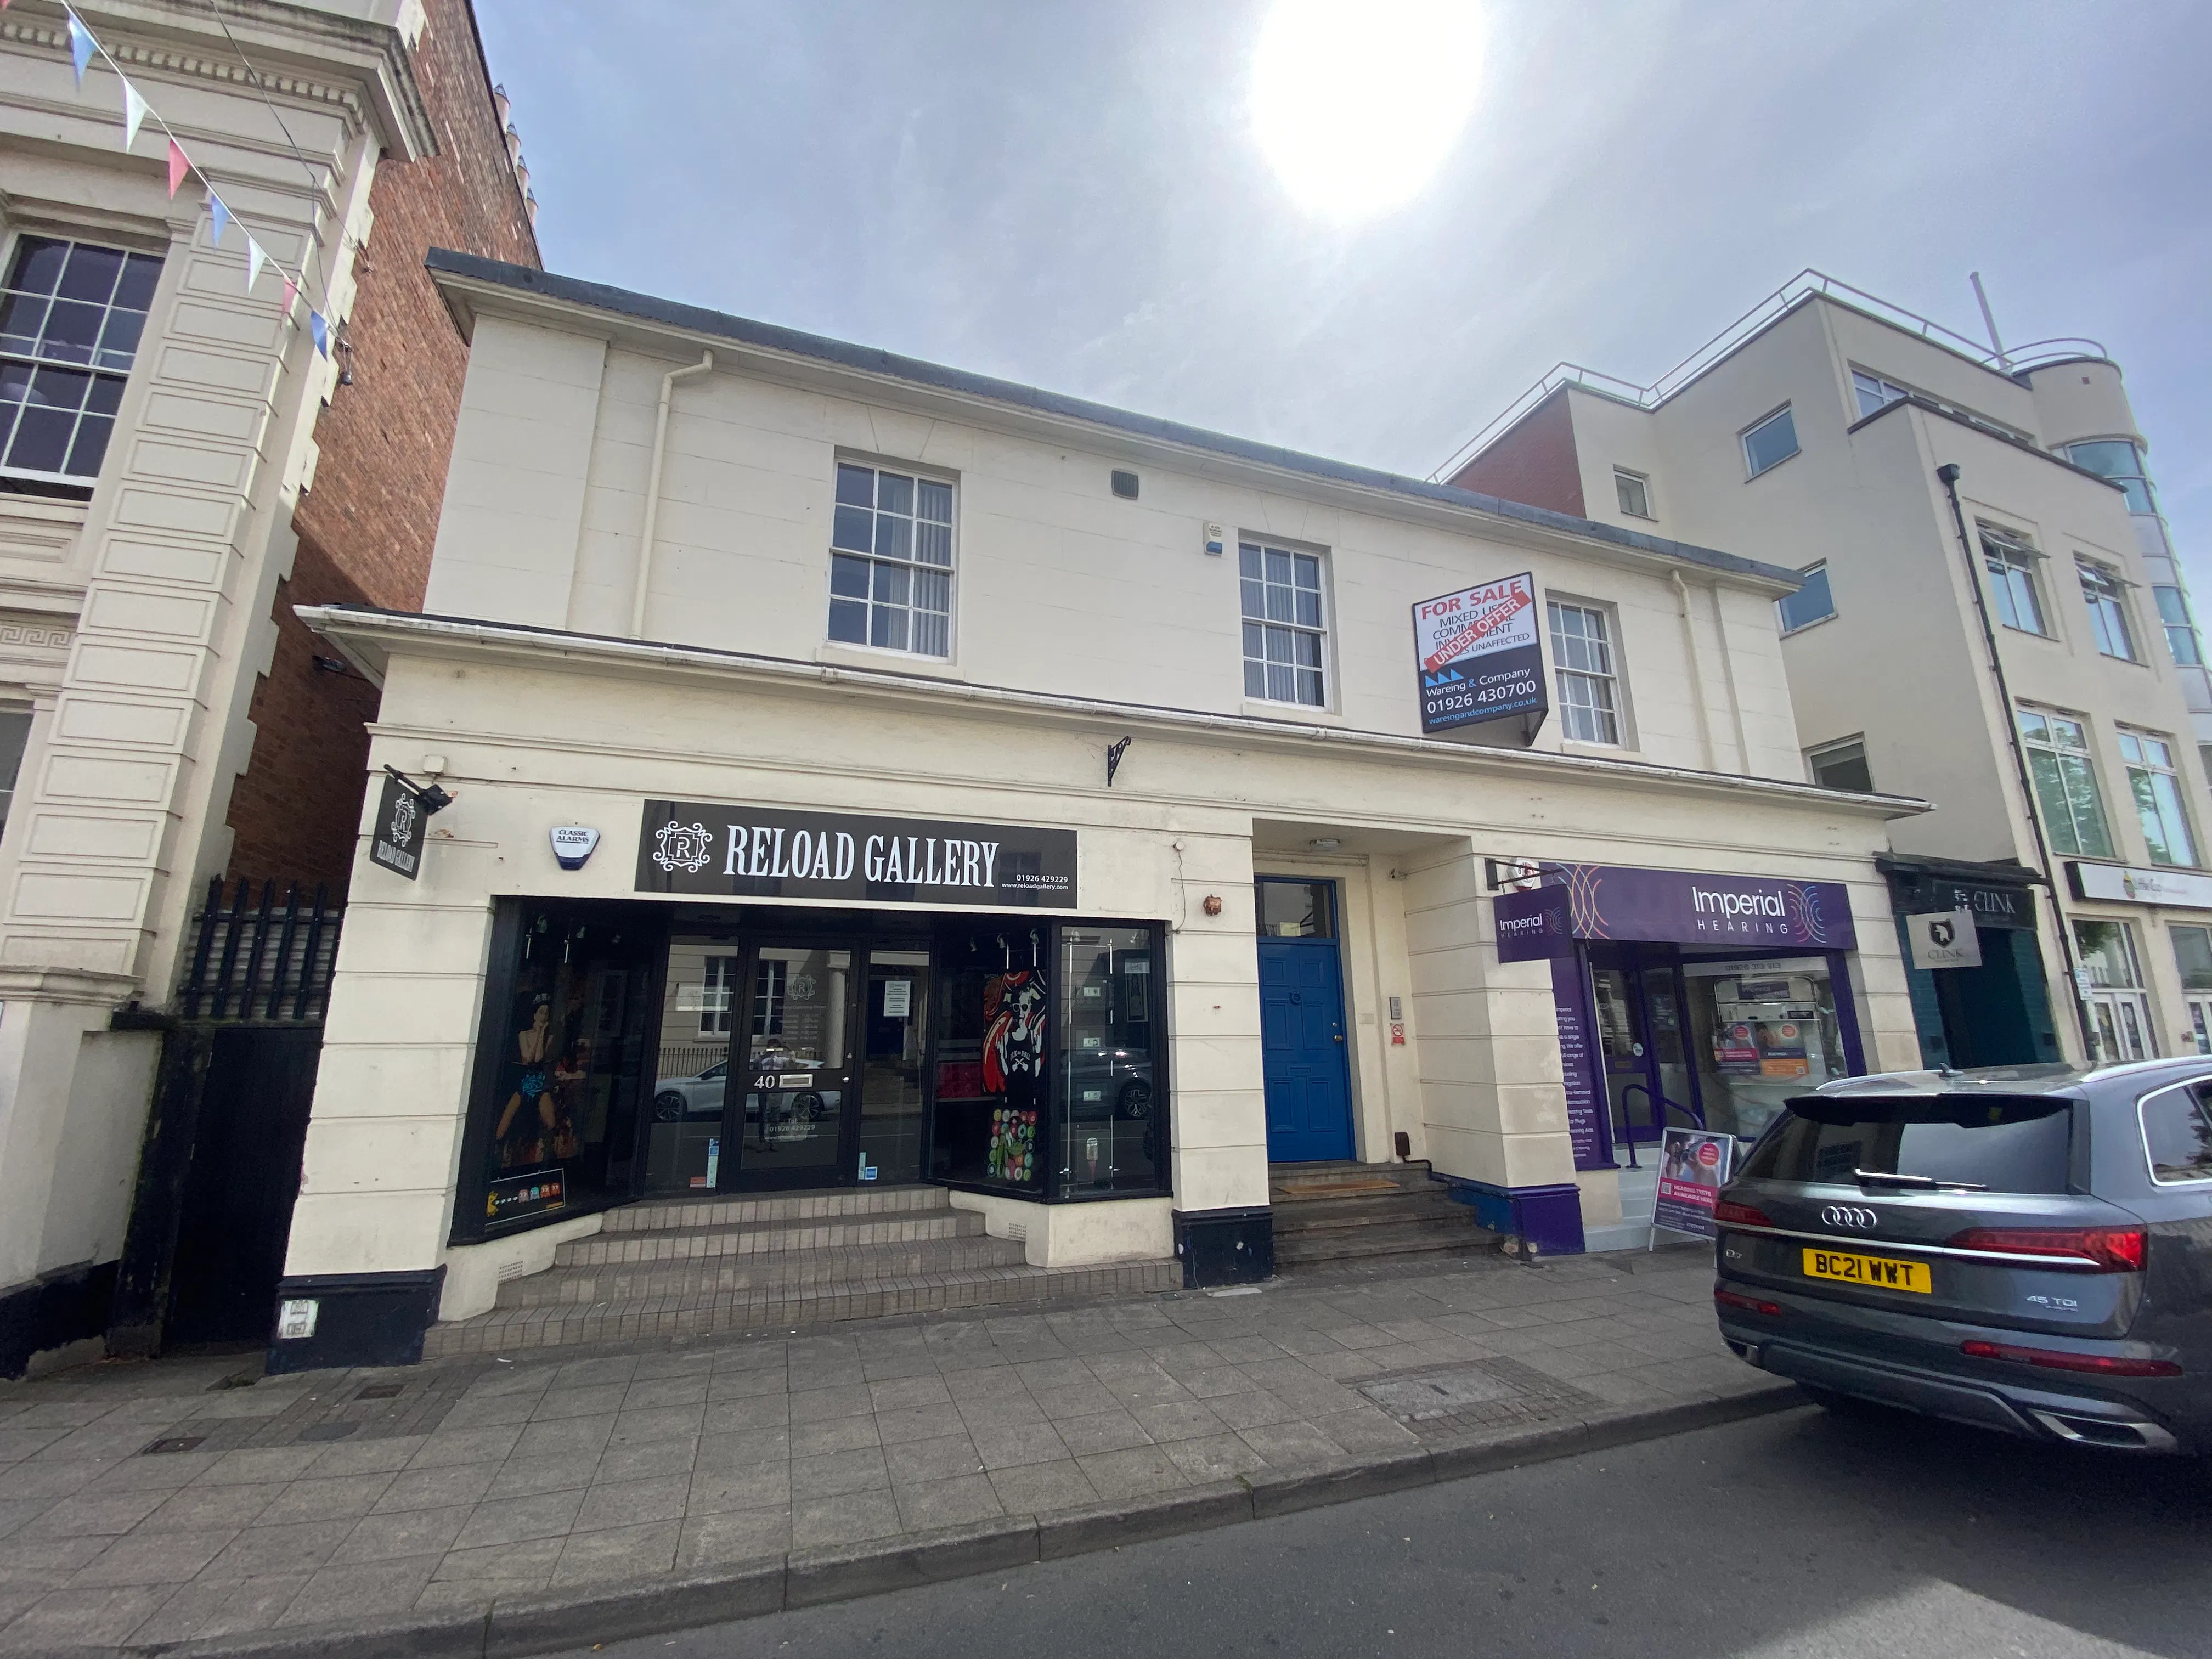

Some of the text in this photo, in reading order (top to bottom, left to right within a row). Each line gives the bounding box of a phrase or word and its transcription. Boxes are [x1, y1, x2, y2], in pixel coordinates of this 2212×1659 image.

[1421, 580, 1522, 620] FOR SALE
[1440, 610, 1479, 628] MIXED
[1432, 629, 1477, 665] UNDER
[1476, 599, 1521, 632] OFFER
[1471, 633, 1530, 652] UNAFFECTED
[1426, 668, 1531, 697] Wareing & Company
[1427, 680, 1536, 714] 01926 430700
[1429, 696, 1537, 725] wareingandcompany.co.uk
[722, 825, 1000, 887] RELOAD GALLERY
[1016, 874, 1040, 882] 01926
[1692, 886, 1785, 919] Imperial
[1500, 913, 1543, 932] Imperial
[1500, 928, 1543, 938] HEARING
[1697, 919, 1788, 934] HEARING
[754, 1075, 775, 1089] 40
[1815, 1253, 1914, 1286] BC21 WWT
[2025, 1295, 2078, 1307] 45 TDI
